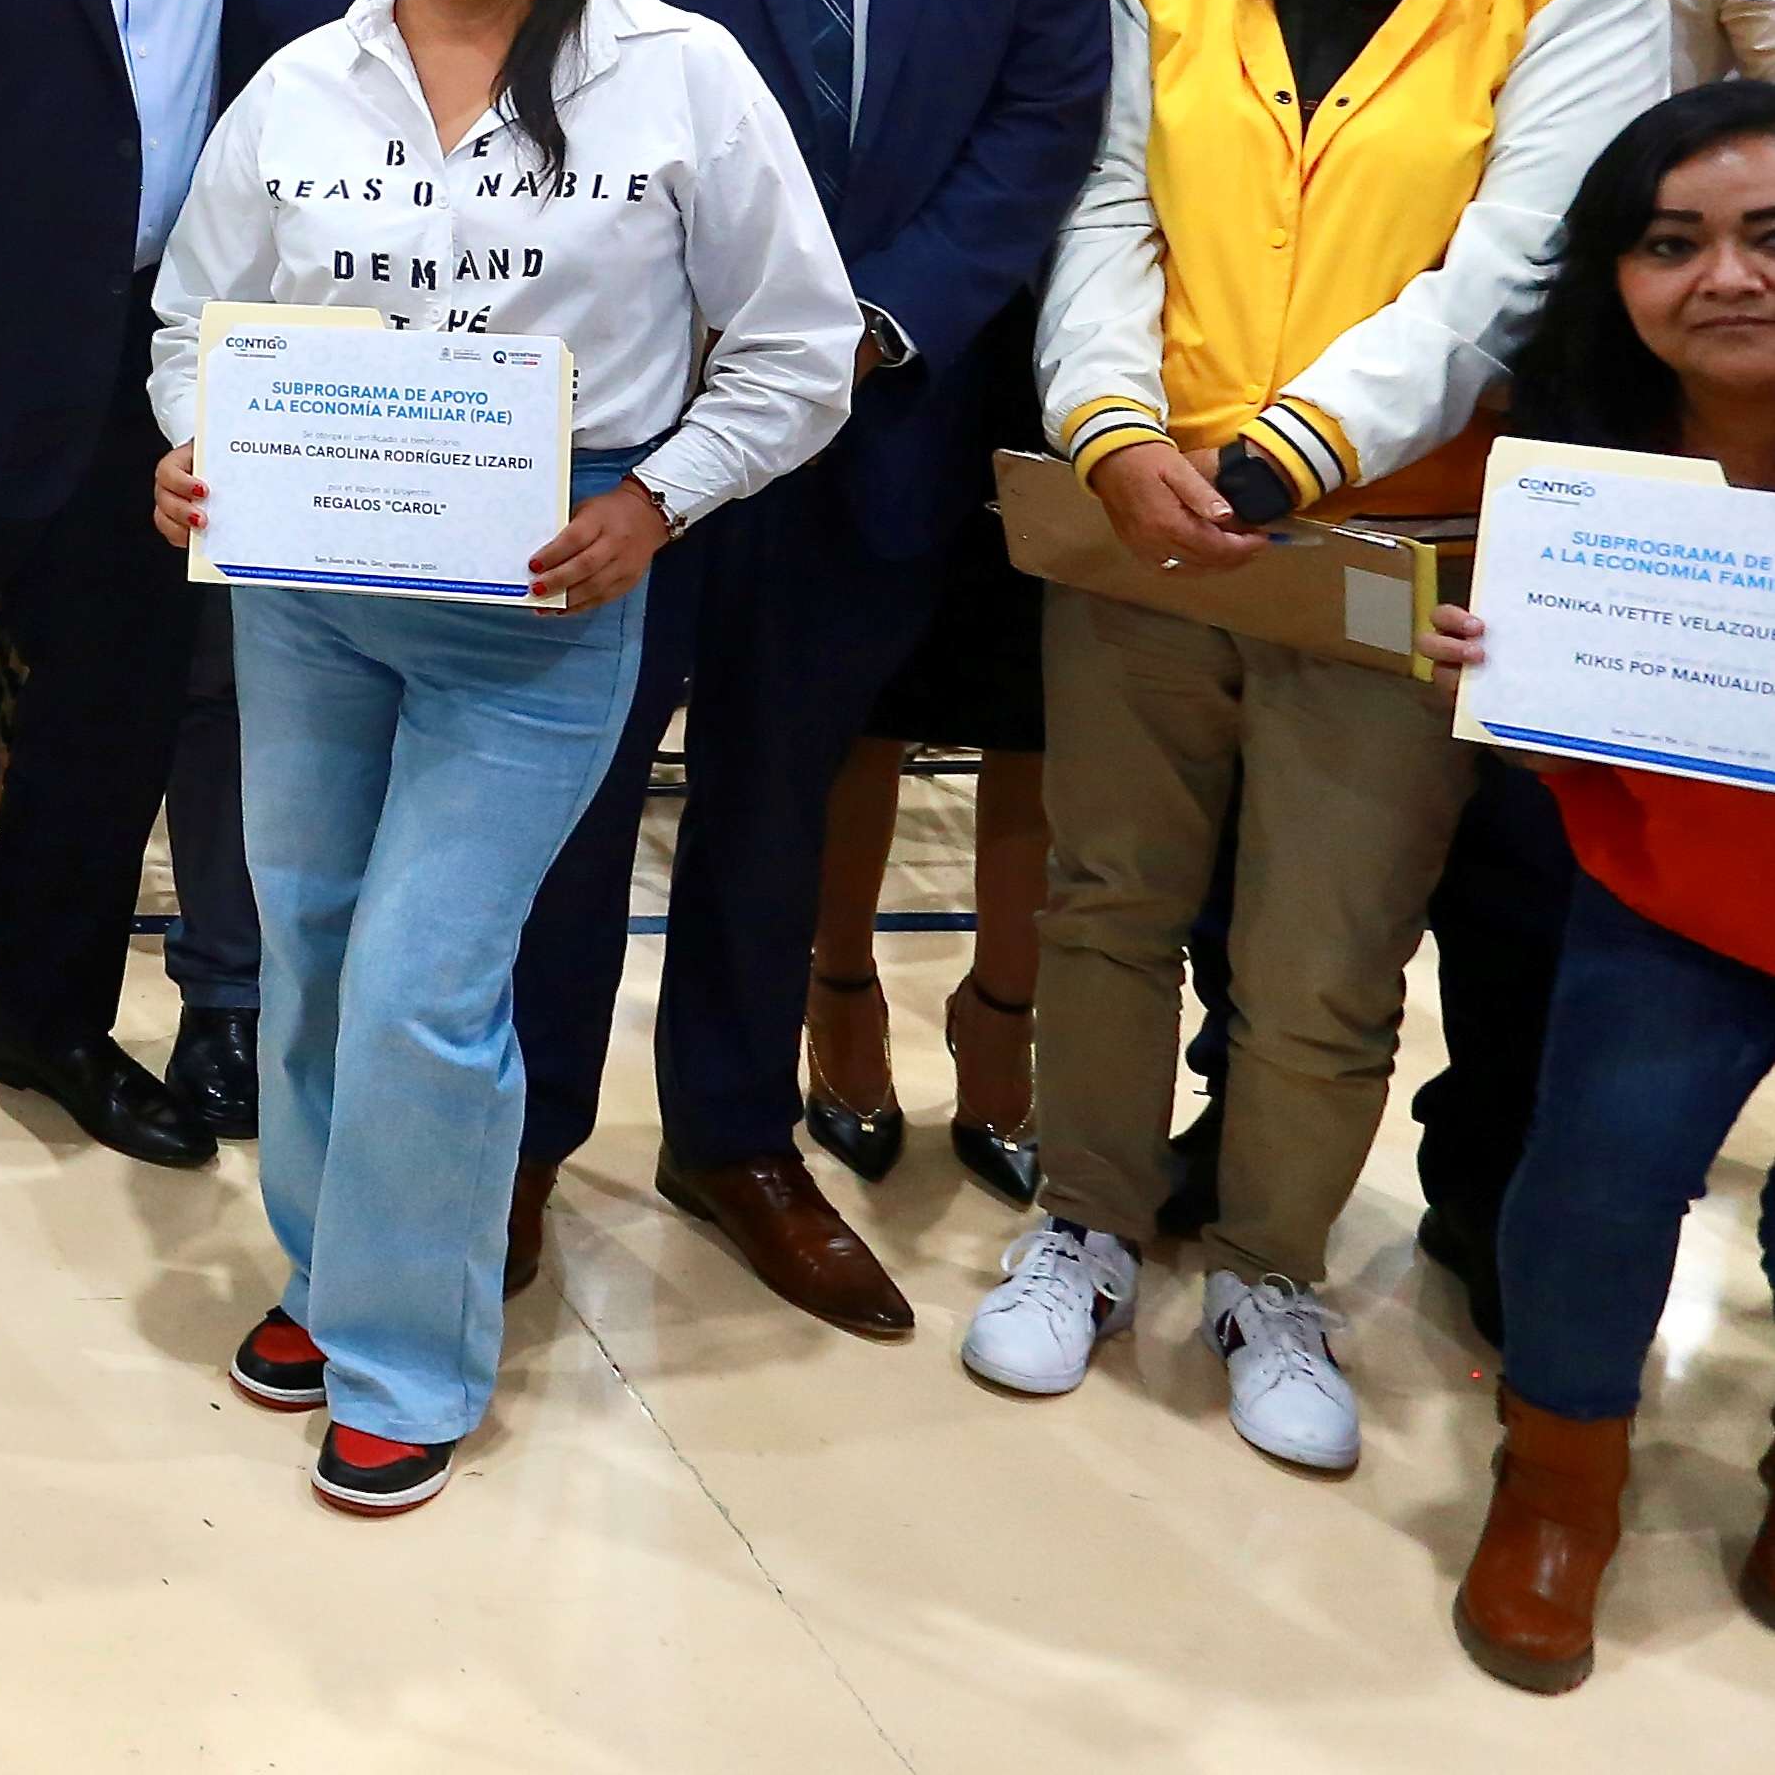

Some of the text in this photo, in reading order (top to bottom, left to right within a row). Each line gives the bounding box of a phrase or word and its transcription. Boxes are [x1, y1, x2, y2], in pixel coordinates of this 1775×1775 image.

[333, 248, 545, 291] DEMAND
[225, 335, 287, 352] CONTIGO
[272, 381, 488, 405] SUBPROGRAMA DE APOYO
[248, 398, 512, 425] A LA ECONOMÍA FAMILIAR (PAE)
[230, 440, 533, 470] COLUMBA CAROLINA RODRÍGUEZ LIZARDI
[1518, 477, 1596, 498] CONTIGO
[313, 496, 447, 515] REGALOS "CAROL"
[1572, 530, 1771, 571] SUBPROGRAMA DE
[1527, 592, 1603, 615] MONIKA
[1608, 605, 1673, 626] IVETTE
[1671, 667, 1775, 695] MANUALID
